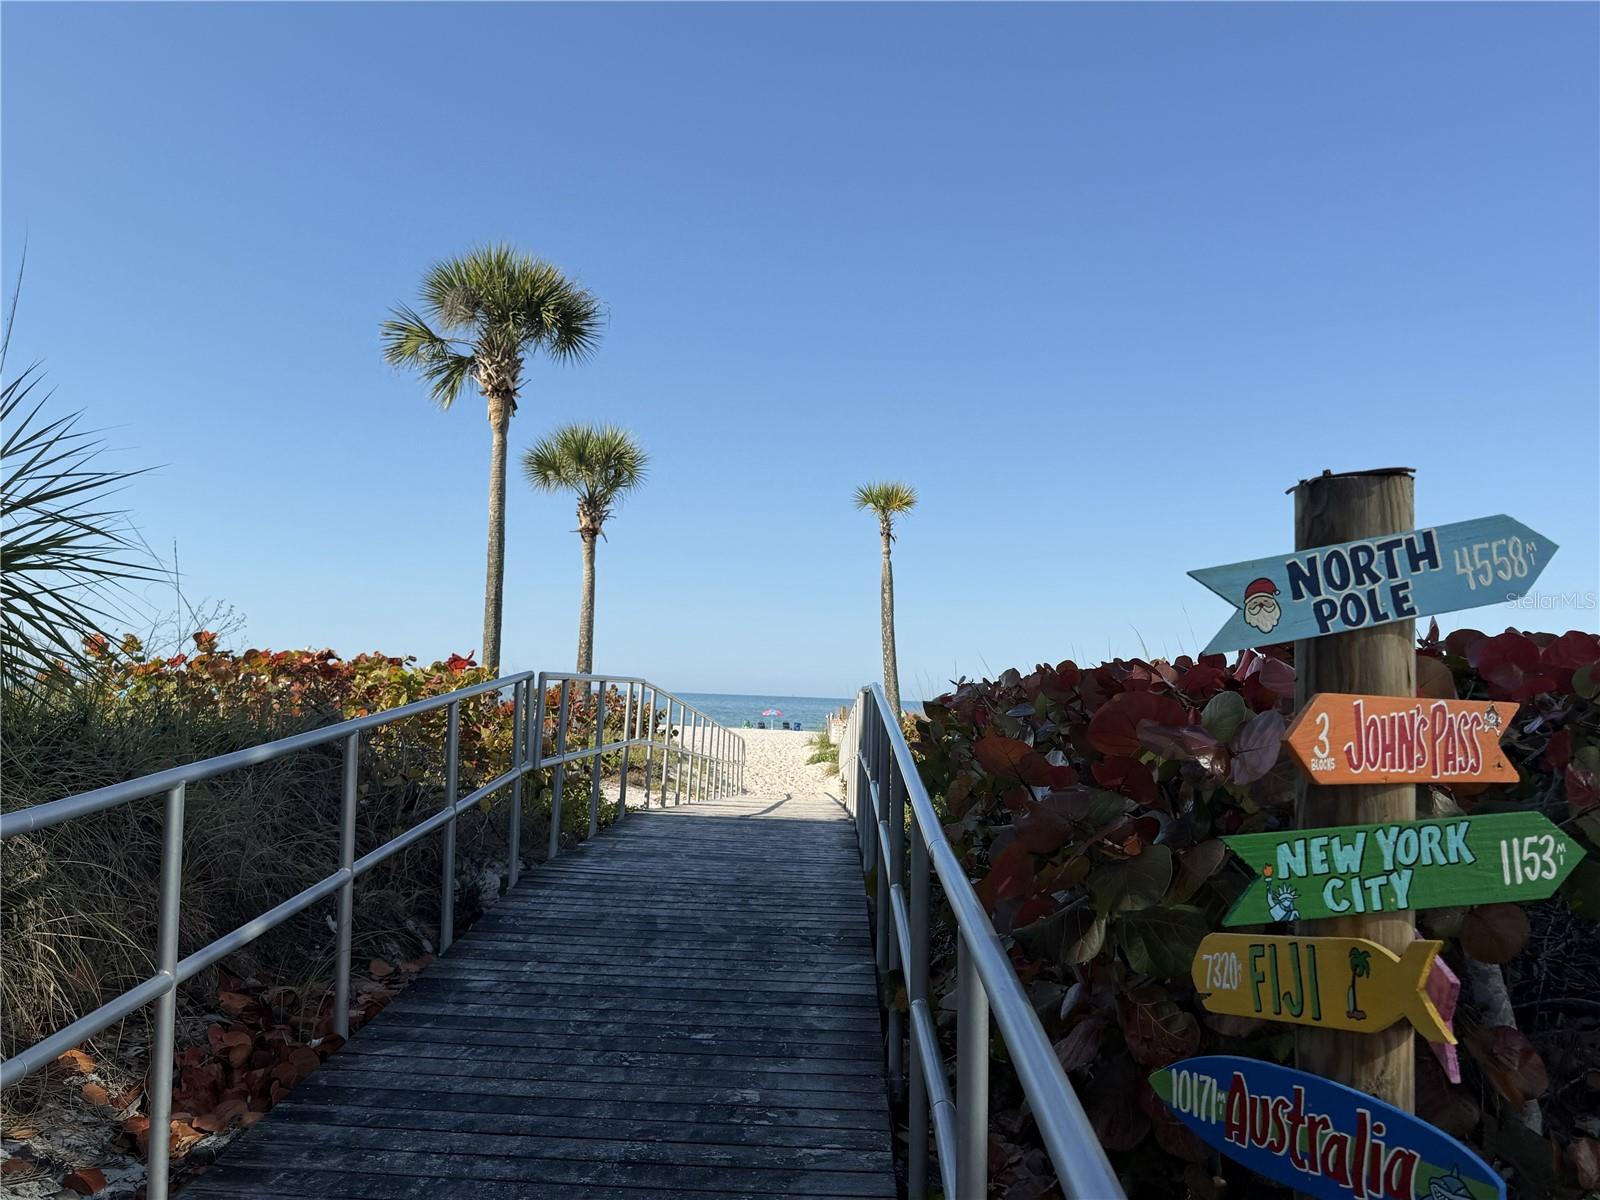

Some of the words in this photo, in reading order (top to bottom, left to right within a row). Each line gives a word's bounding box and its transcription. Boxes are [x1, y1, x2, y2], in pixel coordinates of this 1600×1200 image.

[1285, 528, 1440, 600] NORTH
[1453, 535, 1528, 590] 4558
[1312, 581, 1418, 634] POLE
[1313, 712, 1330, 759] 3
[1430, 700, 1484, 779] PASS
[1276, 831, 1366, 879] NEW
[1375, 821, 1477, 868] YORK
[1500, 834, 1557, 886] 1153
[1321, 868, 1414, 913] CITY
[1202, 952, 1238, 991] 7320
[1248, 942, 1321, 1021] FIJI
[1171, 1068, 1217, 1125] 10171
[1224, 1071, 1421, 1200] Australia
